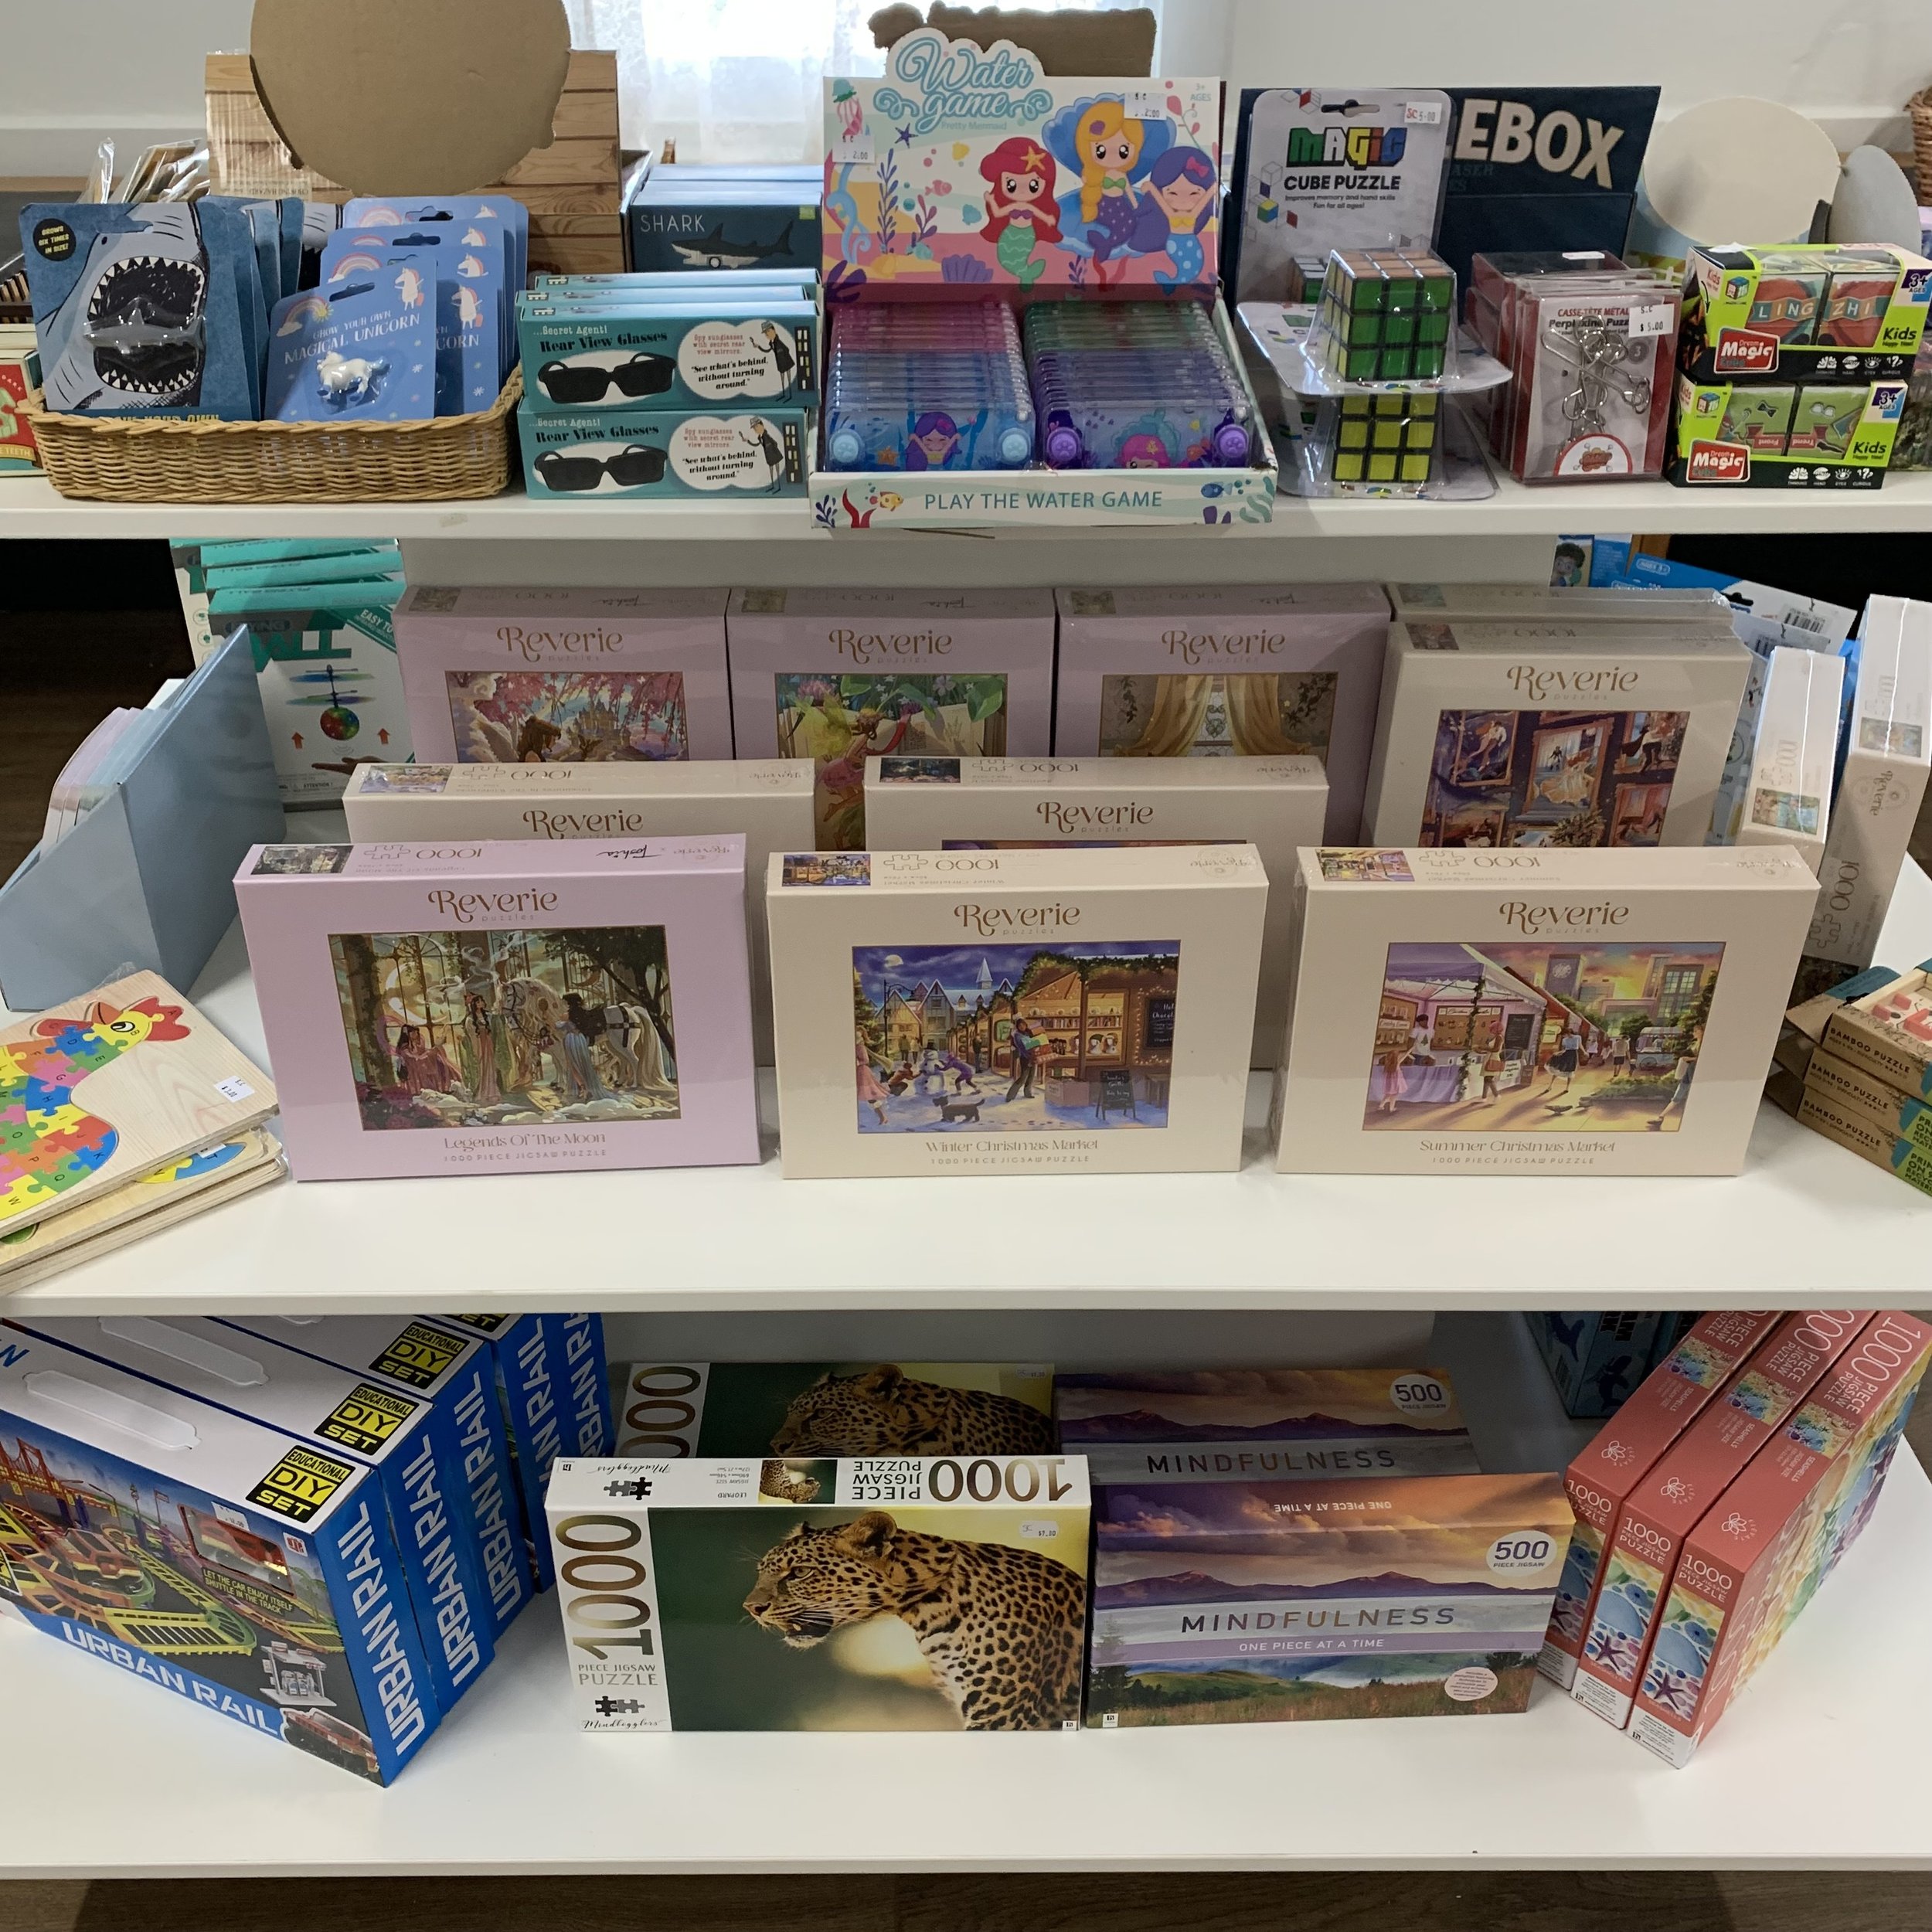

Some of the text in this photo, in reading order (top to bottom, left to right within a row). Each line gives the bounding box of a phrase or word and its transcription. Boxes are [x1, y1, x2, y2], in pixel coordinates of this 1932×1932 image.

[896, 36, 1034, 92] Water
[1284, 175, 1401, 191] CUBE PUZZLE
[641, 214, 705, 233] SHARK
[1910, 274, 1928, 288] 3+
[1759, 301, 1870, 318] LING ZHI
[284, 313, 420, 365] MAGICAL UNICORN
[312, 311, 392, 340] GROW YOUR OWN
[1883, 326, 1917, 342] Kids
[540, 332, 668, 352] Rear View Glasses
[1721, 342, 1773, 359] Magic
[699, 368, 764, 383] without turning
[709, 361, 736, 371] what's
[5, 446, 31, 457] TEETH
[1693, 451, 1744, 470] Magic
[1852, 441, 1886, 454] Kids
[925, 491, 1162, 511] PLAY THE WATER GAME
[359, 608, 394, 634] EASY TO
[496, 627, 624, 664] Reverie
[828, 628, 954, 665] Reverie
[1162, 630, 1287, 665] Reverie
[1507, 665, 1640, 702] Reverie
[1870, 770, 1893, 817] Reverie
[522, 808, 645, 840] Reverie
[1036, 801, 1155, 834] Reverie
[1474, 854, 1542, 869] 1000
[427, 888, 559, 924] Reverie
[954, 903, 1080, 937] Reverie
[1498, 901, 1630, 934] Reverie
[1830, 1026, 1911, 1074] BAMBOO PUZZLE
[1811, 1062, 1889, 1110] BAMBOO PUZZLE
[1804, 1099, 1882, 1147] BAMBOO PUZZLE
[444, 1133, 606, 1153] Legends Of The Moon
[477, 1152, 510, 1161] PIECE
[926, 1139, 1099, 1152] Winter Christmas Market
[1419, 1139, 1616, 1152] Summer Christmas Market
[1851, 1316, 1921, 1382] 1000
[351, 1386, 411, 1416] EDUCATIONAL
[1395, 1383, 1443, 1404] 500
[1823, 1370, 1854, 1403] PUZZLE
[1835, 1376, 1865, 1408] JIGSAW
[1845, 1382, 1879, 1414] PIECE
[337, 1402, 398, 1434] DIY
[323, 1423, 378, 1450] SET
[287, 1450, 348, 1481] EDUCATIONAL
[853, 1460, 921, 1471] PUZZLE
[1148, 1448, 1396, 1475] MINDFULNESS
[1791, 1455, 1816, 1483] SEASHELLS
[268, 1466, 333, 1500] DIY
[851, 1485, 921, 1500] PIECE
[852, 1471, 923, 1485] JIGSAW
[928, 1458, 1073, 1502] 1000
[256, 1489, 312, 1517] SET
[455, 1371, 523, 1623] URBAN RAIL
[1567, 1479, 1612, 1513] 1000
[1619, 1534, 1665, 1565] PUZZLE
[1623, 1516, 1672, 1553] 1000
[402, 1434, 482, 1688] URBAN RAIL
[1495, 1540, 1549, 1561] 500
[1681, 1566, 1728, 1595] PIECE JIGSAW
[1685, 1553, 1733, 1590] 1000
[202, 1568, 293, 1611] LET THE CAR ENJOY ITSELF
[205, 1577, 235, 1596] SHUTTLE
[236, 1590, 243, 1599] IN
[245, 1594, 259, 1605] THE
[554, 1513, 655, 1662] 1000
[1678, 1572, 1726, 1604] PUZZLE
[338, 1501, 426, 1757] URBAN RAIL
[1182, 1607, 1455, 1634] MINDFULNESS
[1239, 1638, 1385, 1652] ONE PIECE AT A TIME
[60, 1621, 279, 1737] URBAN RAIL
[579, 1673, 658, 1685] PUZZLE
